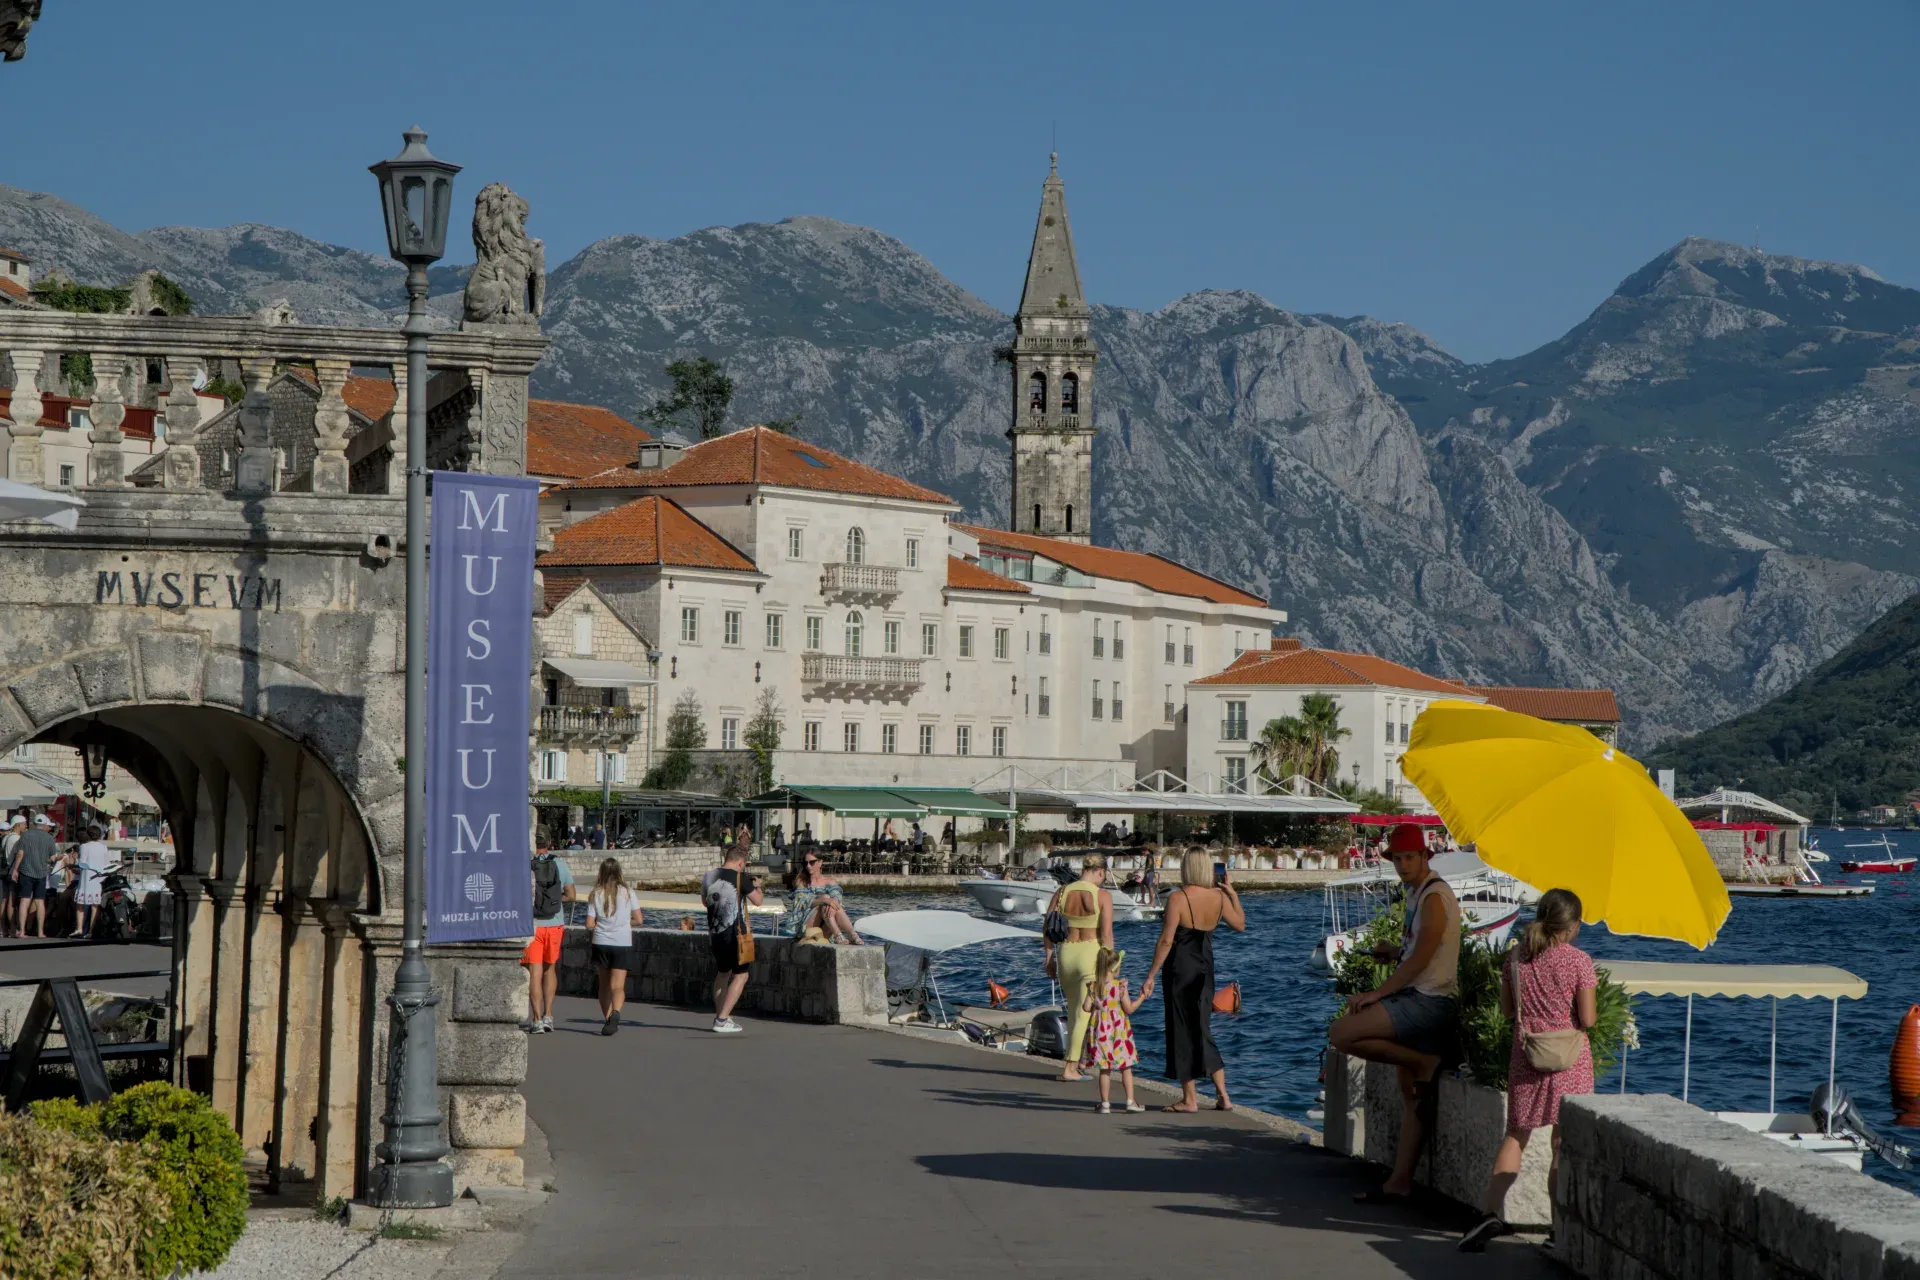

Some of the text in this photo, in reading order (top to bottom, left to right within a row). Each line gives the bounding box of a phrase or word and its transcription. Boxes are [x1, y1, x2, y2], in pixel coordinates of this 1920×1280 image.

[94, 571, 282, 614] MVSEVM
[452, 490, 510, 854] MUSEUM
[441, 910, 519, 923] MUZEJI KOTOR
